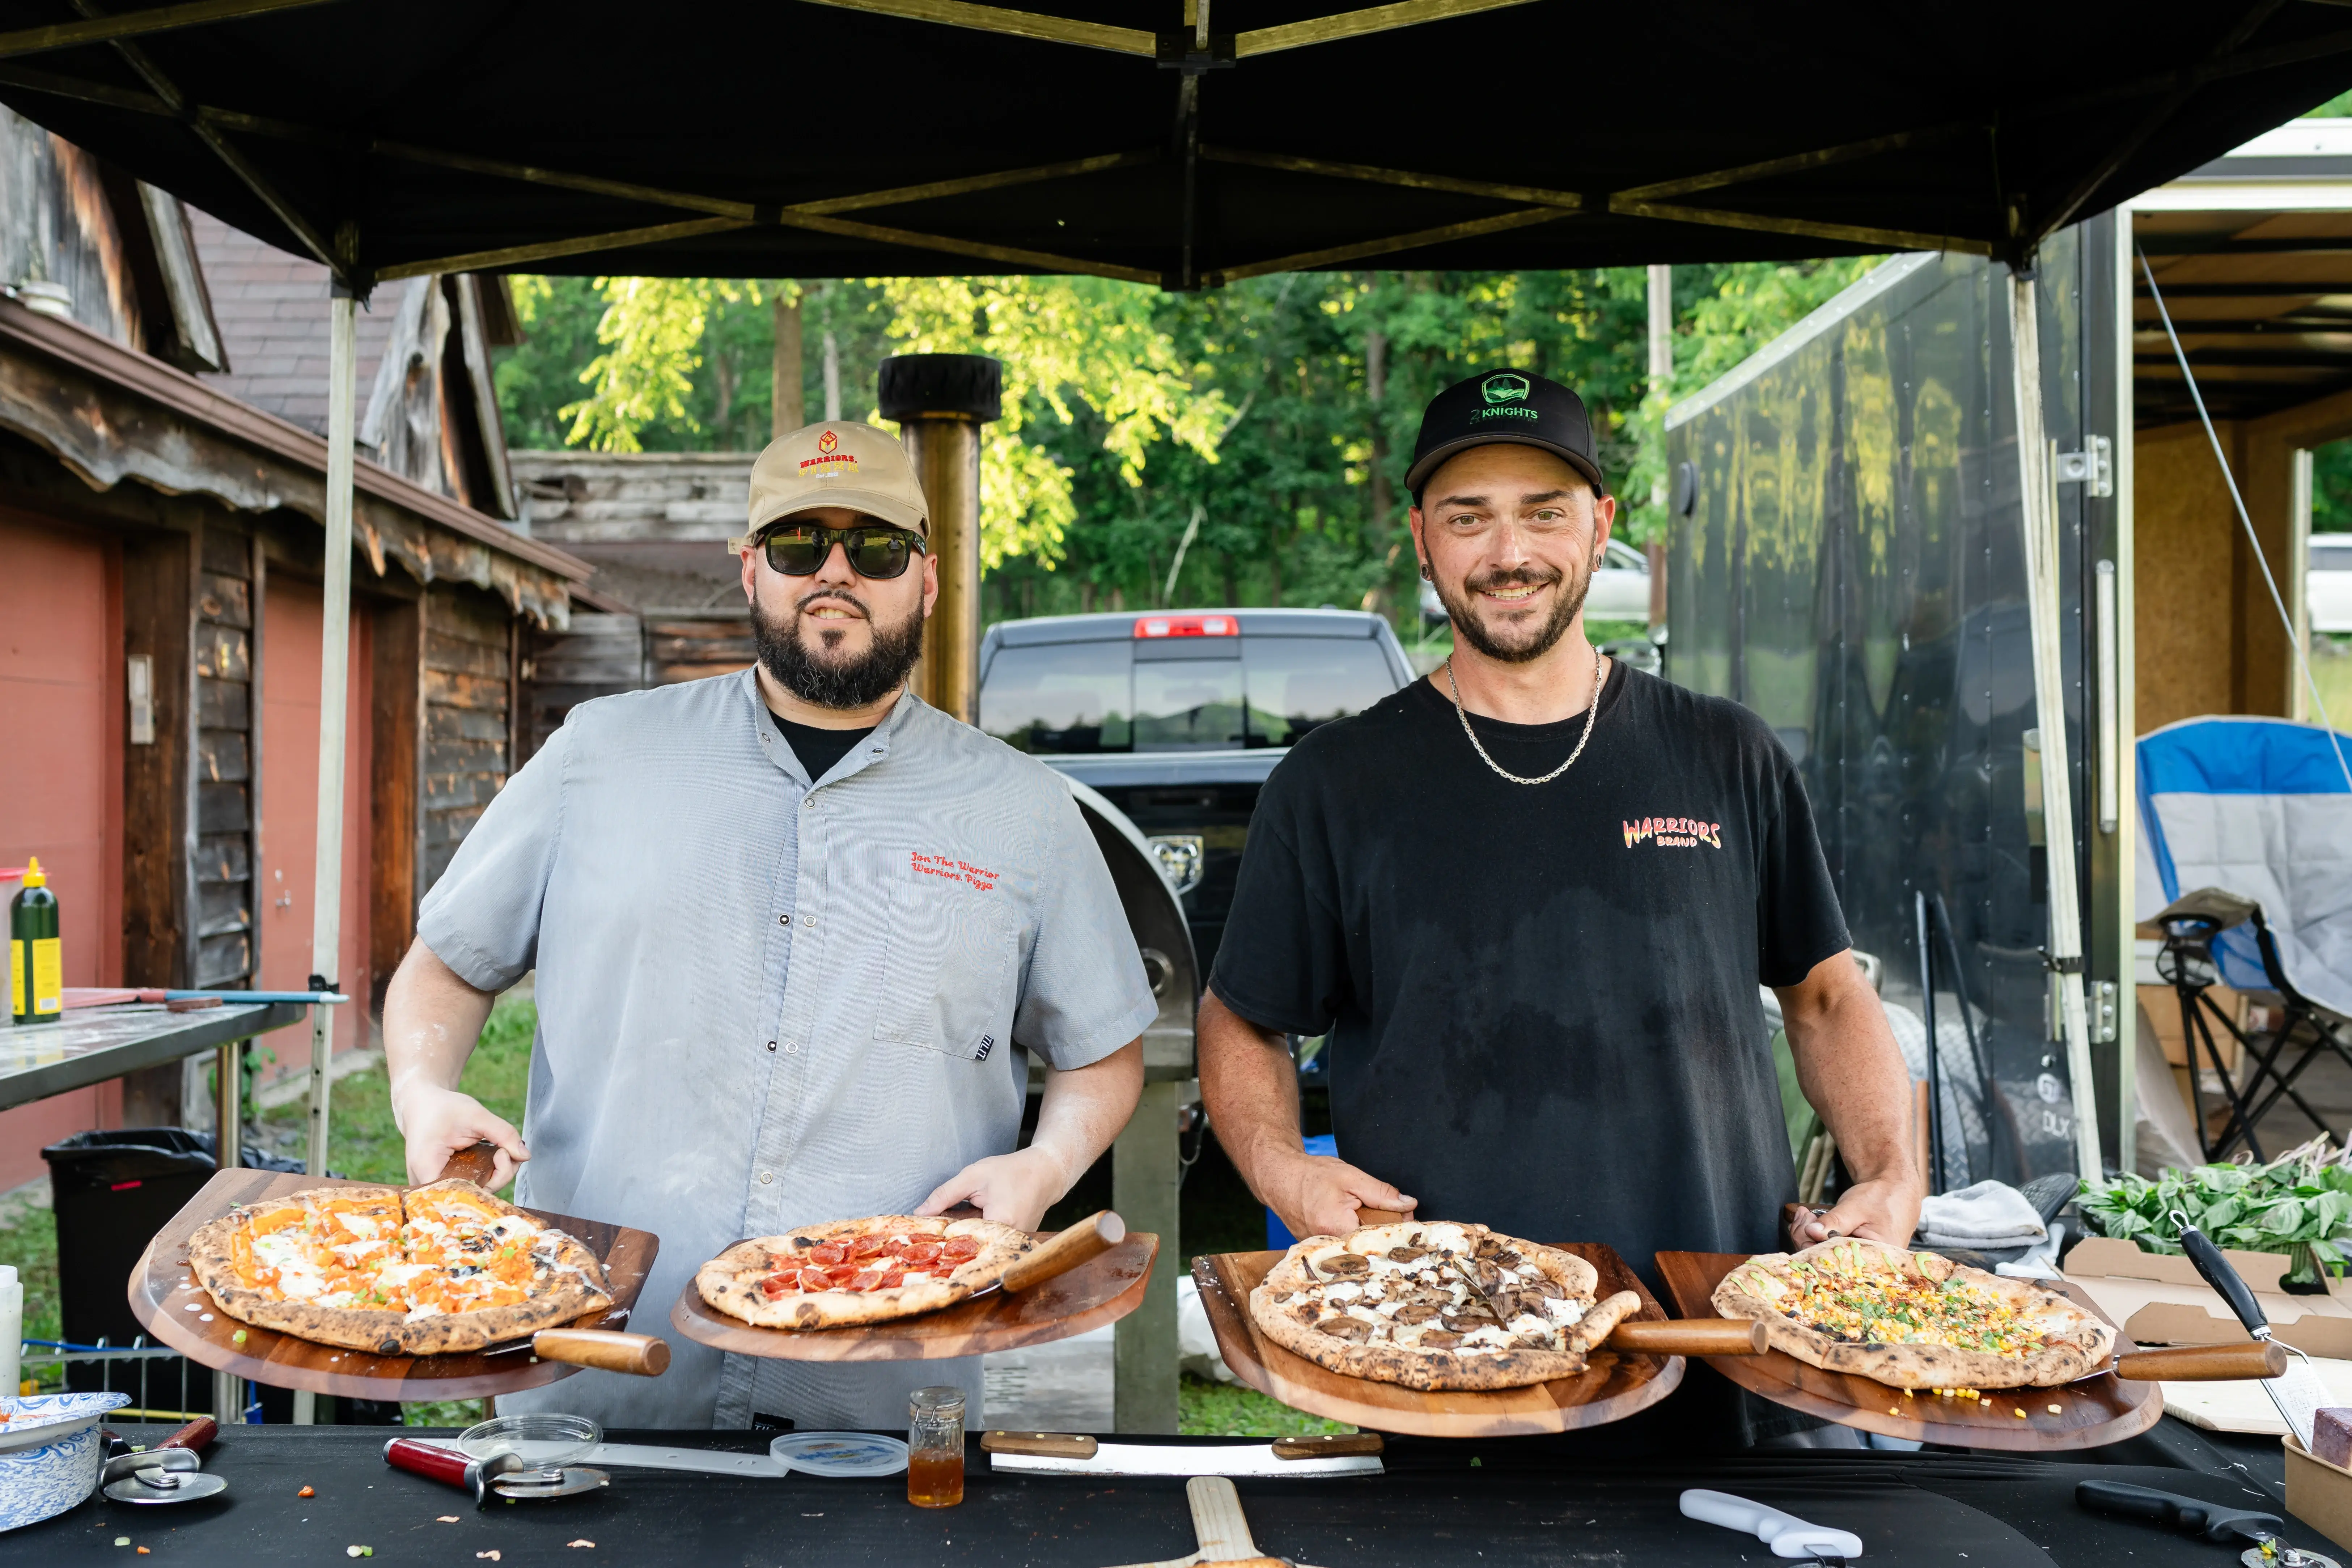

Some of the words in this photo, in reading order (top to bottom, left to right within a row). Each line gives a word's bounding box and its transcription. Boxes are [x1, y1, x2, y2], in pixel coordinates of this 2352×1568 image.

[1471, 409, 1480, 420] 2
[1482, 407, 1538, 419] KNIGHTS
[798, 462, 859, 477] PIZZA
[1623, 817, 1721, 849] WARRIORS
[1657, 836, 1697, 847] BRAND
[911, 852, 931, 863] Jon
[934, 855, 954, 868] The
[958, 861, 1000, 879] Warrior
[911, 863, 963, 881] Warriors.
[965, 874, 993, 891] Pizza
[977, 1036, 992, 1060] TILIT
